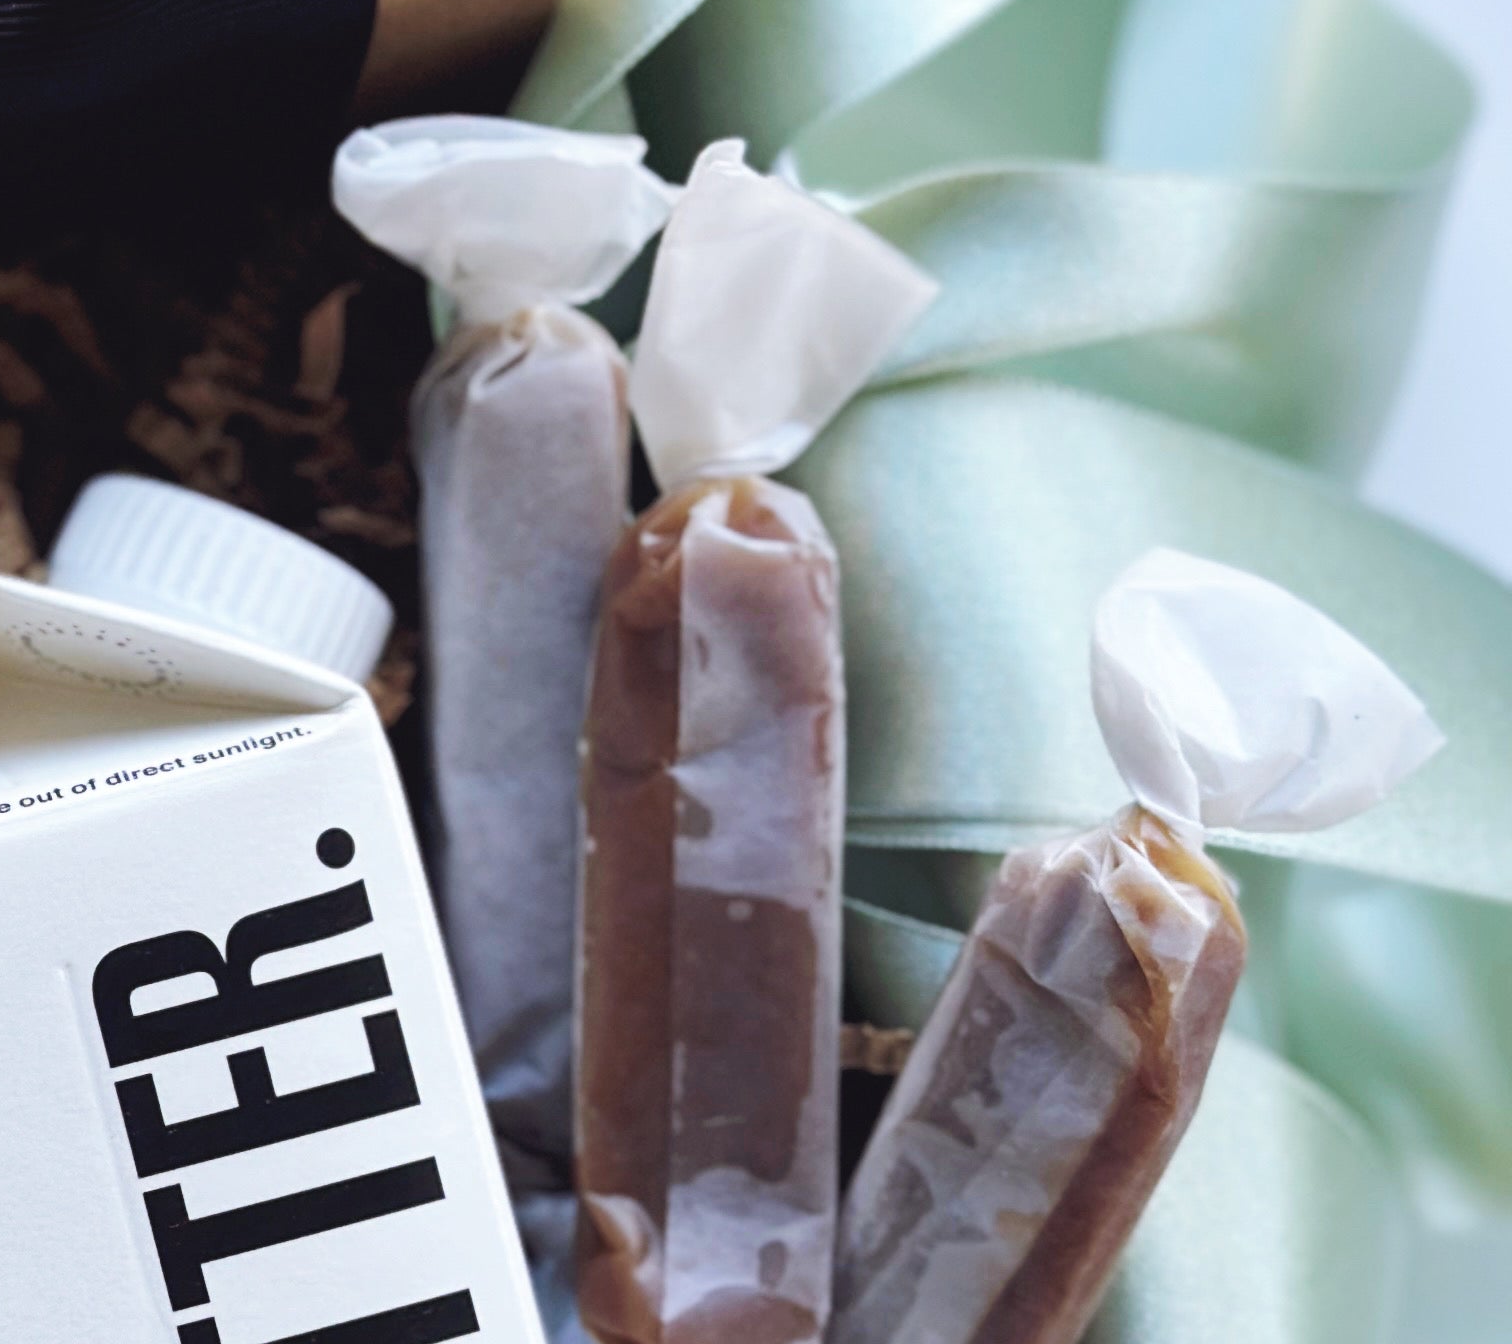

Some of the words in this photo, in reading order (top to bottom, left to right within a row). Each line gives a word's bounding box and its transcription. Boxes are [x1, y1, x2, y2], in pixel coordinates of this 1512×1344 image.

[18, 786, 64, 809] out
[71, 777, 99, 796] of
[105, 756, 187, 787] direct
[192, 727, 314, 766] sunlight.
